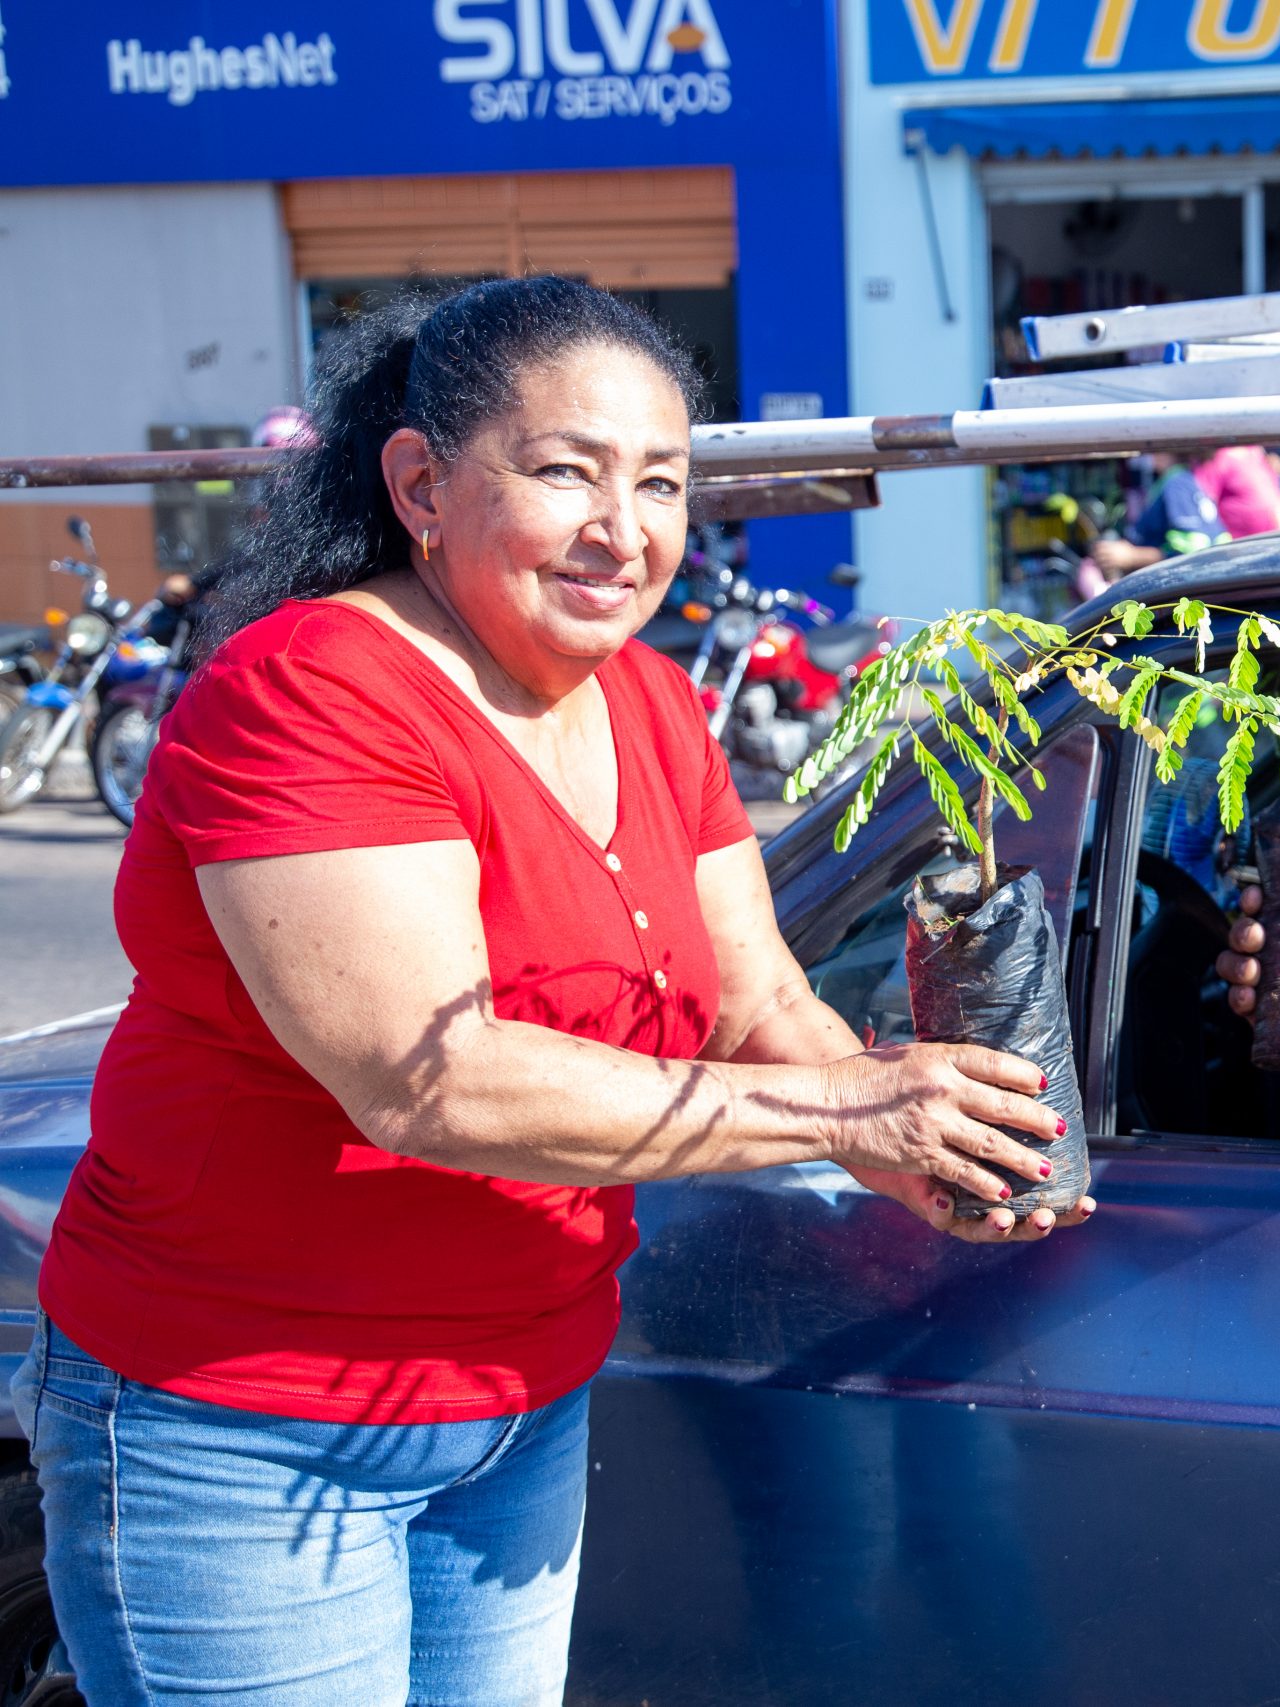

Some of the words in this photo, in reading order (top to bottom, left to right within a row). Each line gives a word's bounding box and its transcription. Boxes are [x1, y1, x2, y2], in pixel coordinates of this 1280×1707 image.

[107, 31, 338, 107] HughesNet
[433, 0, 732, 82] SILVA
[470, 80, 533, 123] SAT
[554, 71, 732, 126] SERVIÇOS
